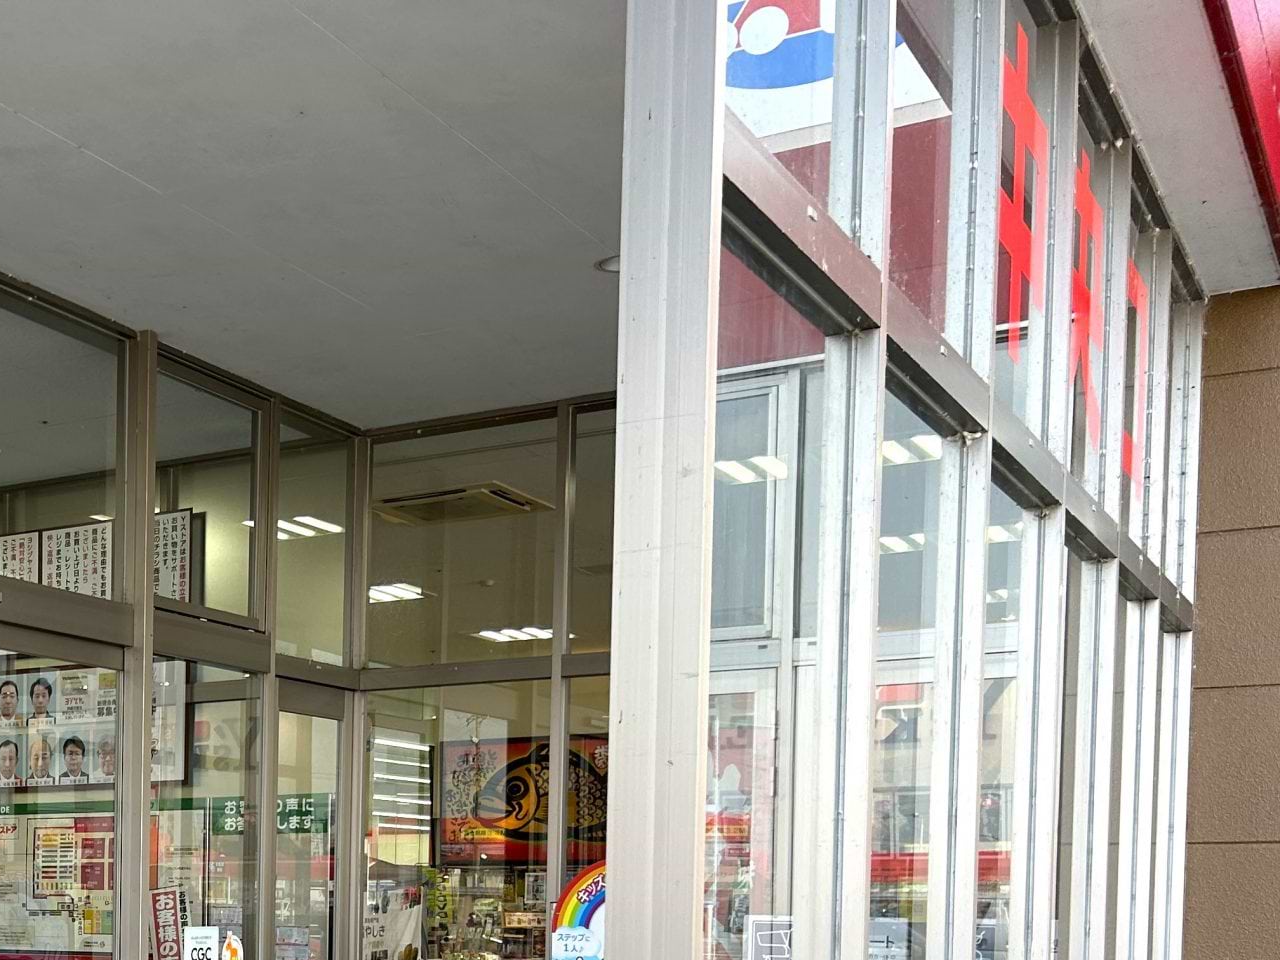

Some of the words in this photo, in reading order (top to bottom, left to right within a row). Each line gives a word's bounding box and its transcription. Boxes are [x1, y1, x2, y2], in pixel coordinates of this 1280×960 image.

[557, 932, 591, 942] ステップに
